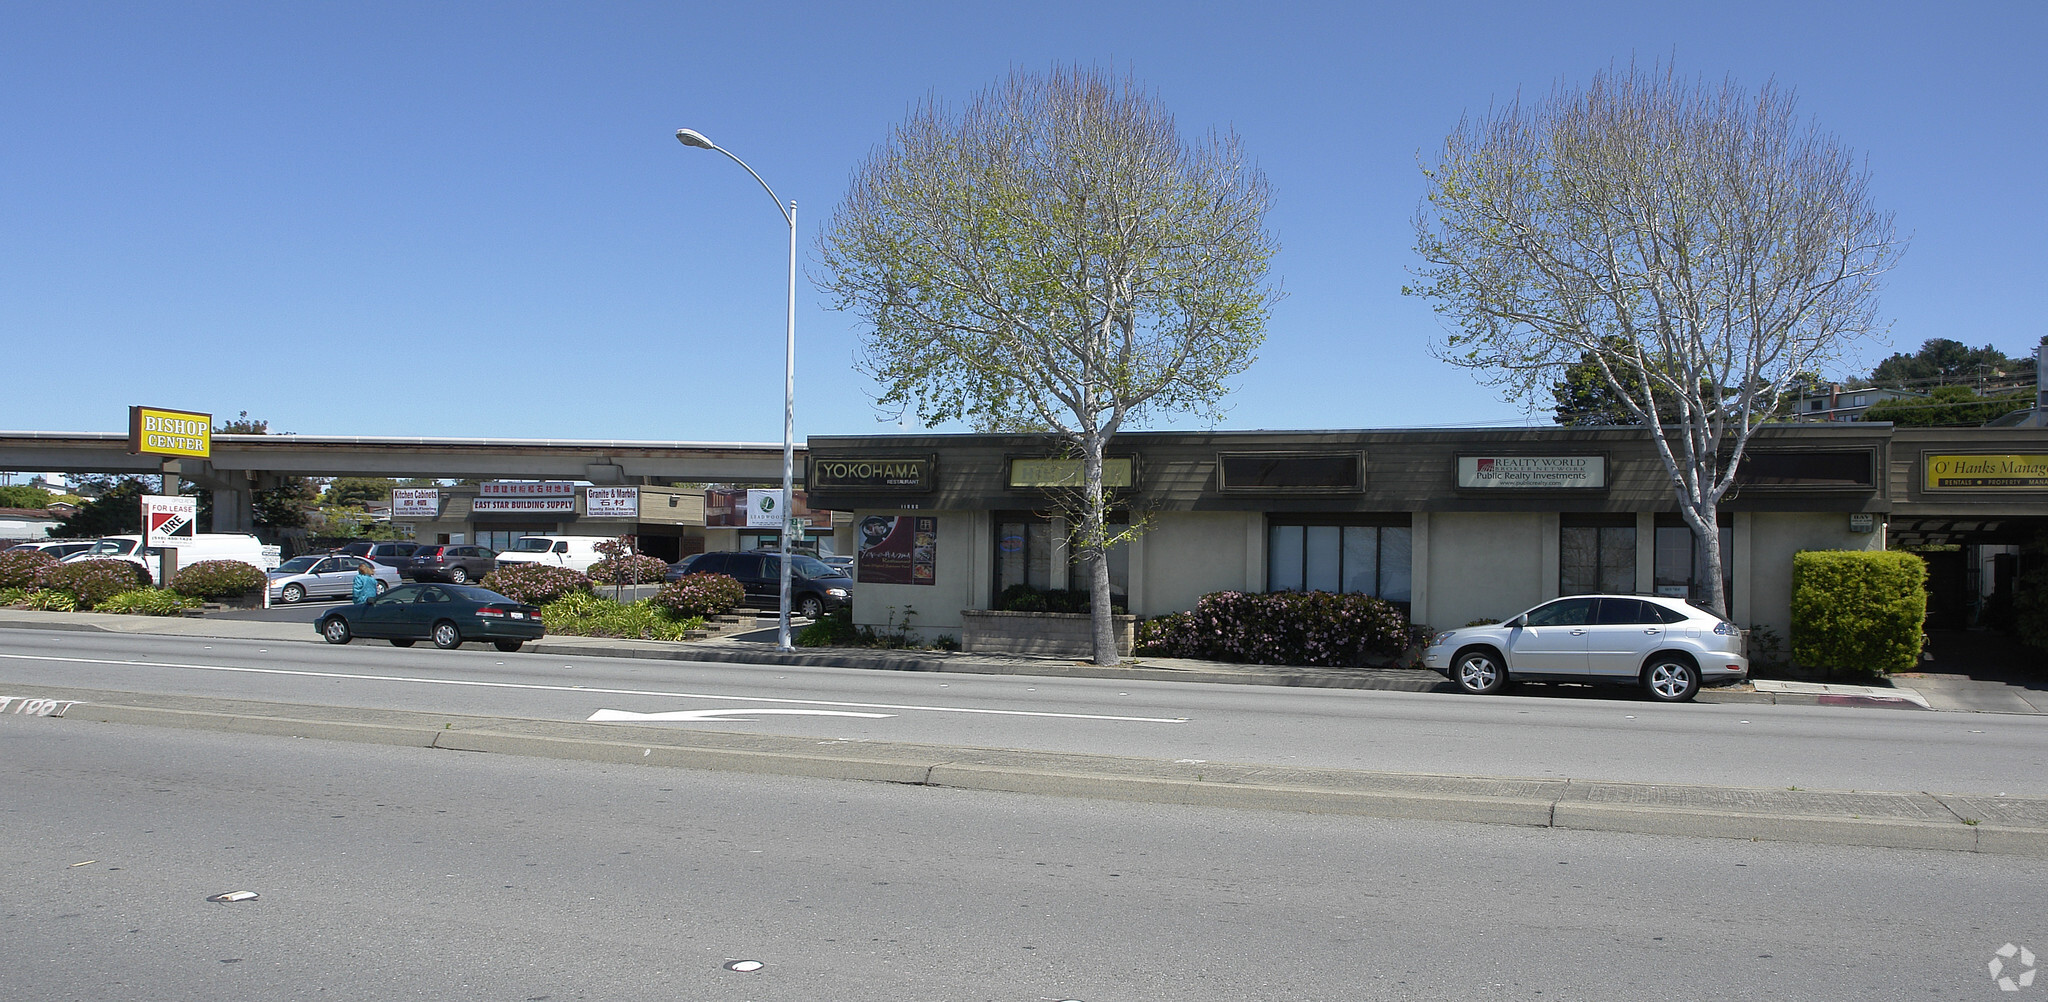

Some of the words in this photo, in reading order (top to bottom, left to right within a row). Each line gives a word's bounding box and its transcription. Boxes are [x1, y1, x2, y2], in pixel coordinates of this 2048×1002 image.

[145, 416, 208, 436] BISHOP
[148, 434, 204, 451] CENTER
[1495, 458, 1539, 466] REALTY
[1541, 458, 1586, 466] WORLD
[1935, 461, 1950, 474] O'
[1954, 460, 1996, 474] Hanks
[823, 463, 920, 479] YOKOHAMA
[1476, 472, 1502, 480] Public
[1504, 472, 1531, 481] Realty
[1533, 472, 1586, 480] Investments
[395, 490, 413, 499] Kitchen
[415, 489, 437, 499] Cabinets
[588, 489, 609, 498] Granite
[611, 489, 616, 498] &
[616, 489, 636, 498] Marble
[152, 504, 168, 512] FOR
[169, 505, 193, 513] LEASE
[474, 501, 491, 509] EAST
[492, 501, 509, 509] STAR
[511, 501, 545, 509] BUILDING
[546, 501, 573, 509] SUPPLY
[159, 515, 185, 535] MRE
